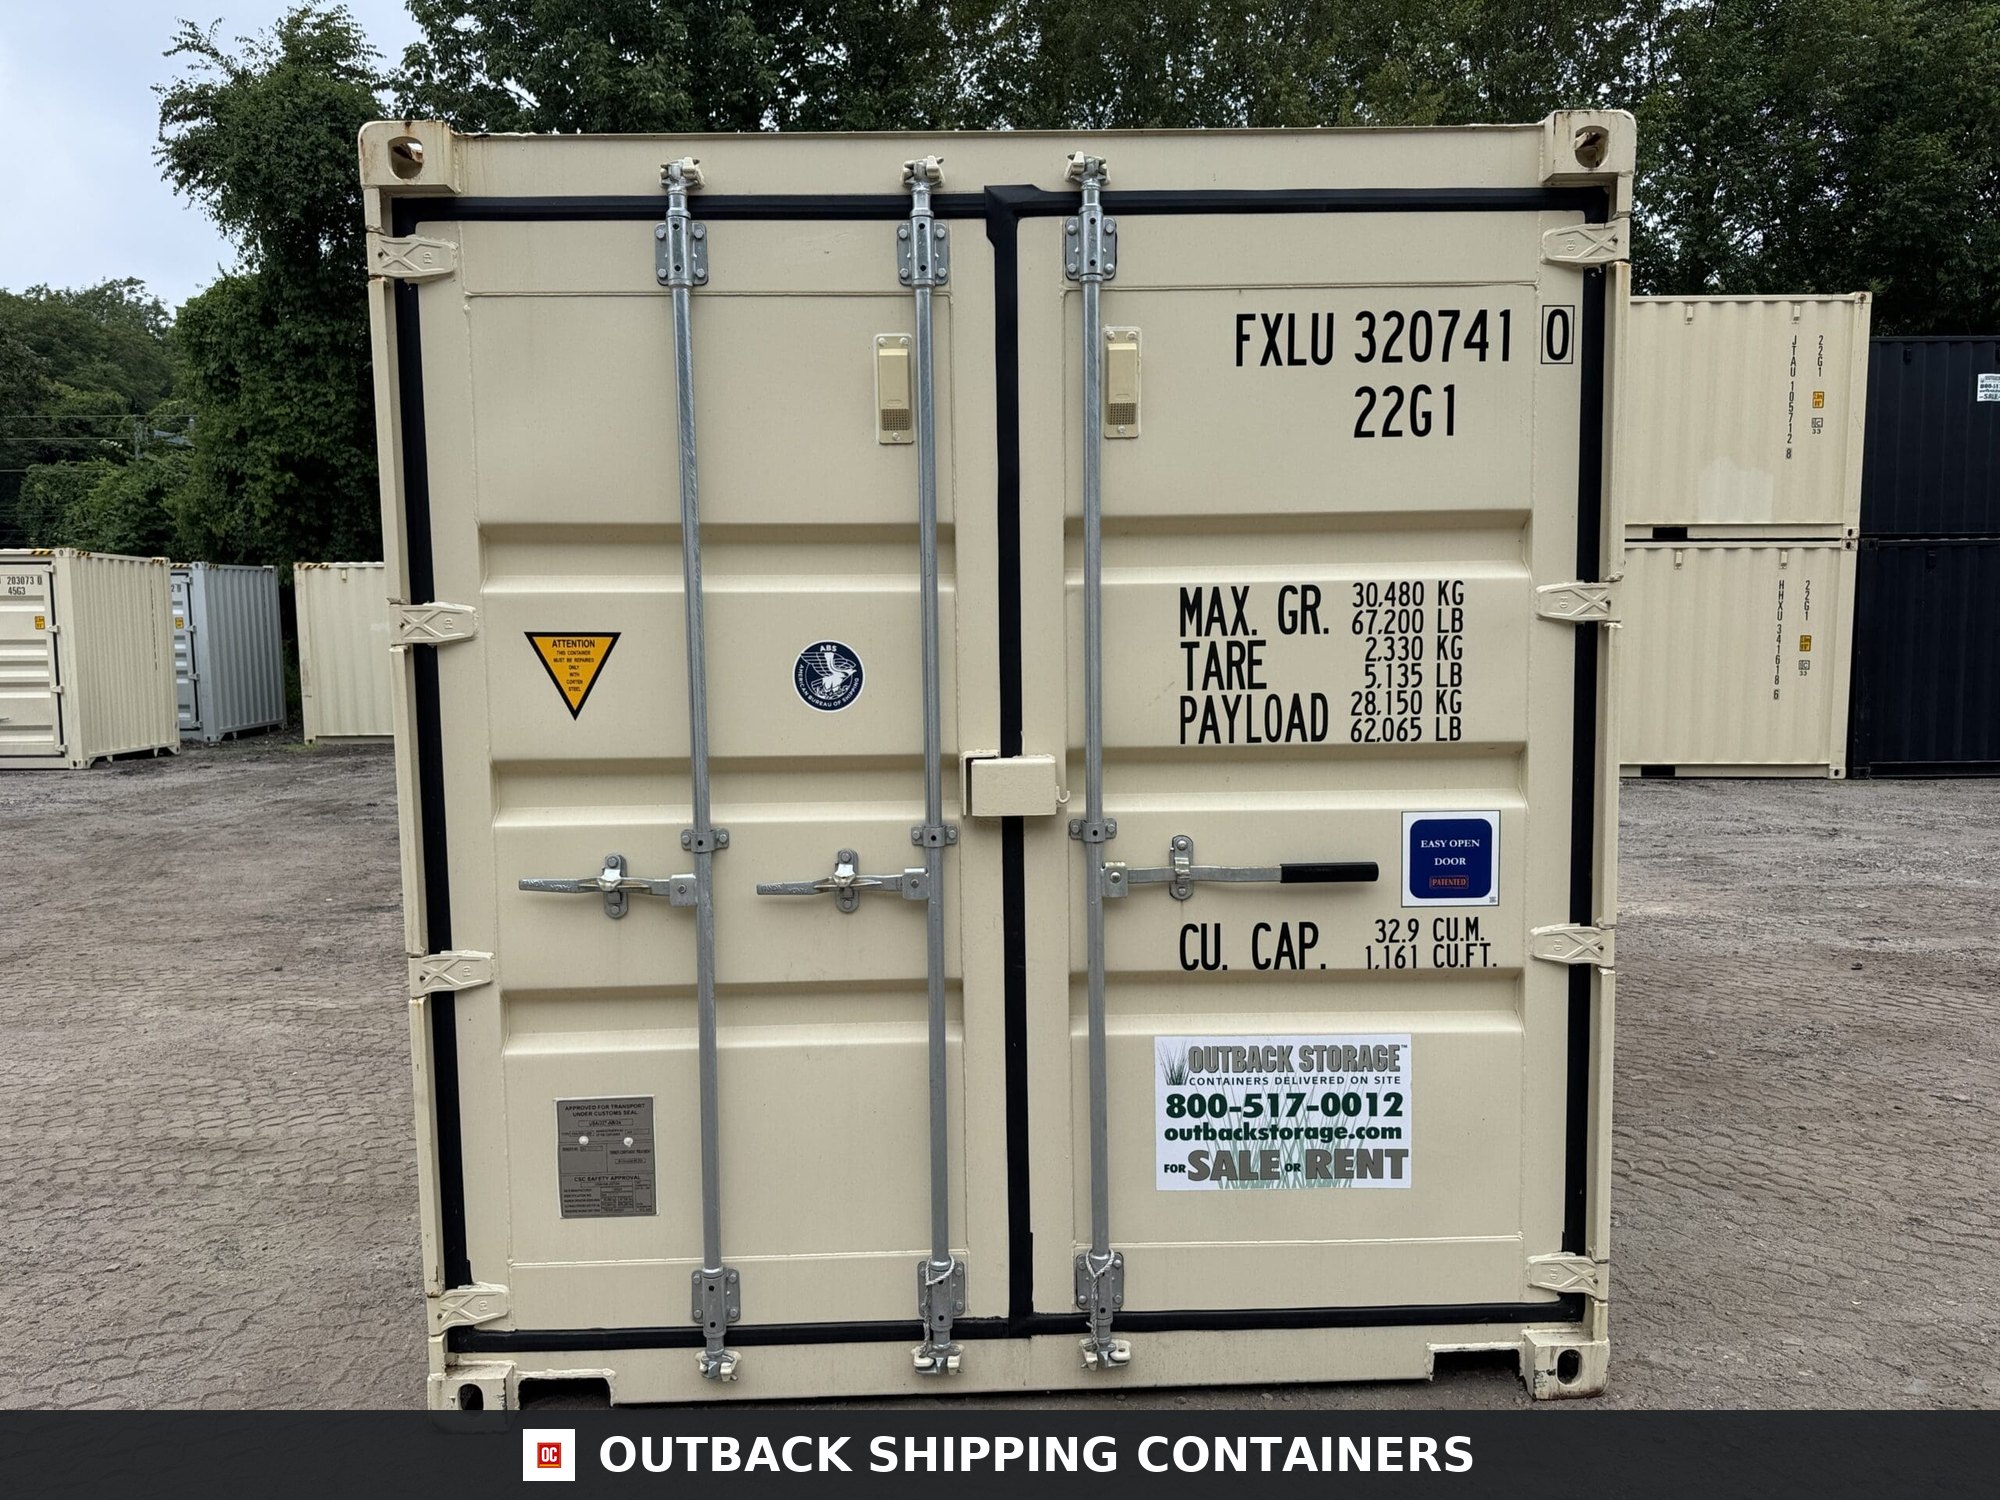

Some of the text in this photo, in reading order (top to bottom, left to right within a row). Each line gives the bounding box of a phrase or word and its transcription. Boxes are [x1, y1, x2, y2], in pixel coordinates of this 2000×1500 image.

[1236, 309, 1569, 366] FXLU 320741 0
[1354, 384, 1454, 438] 22G1
[1786, 448, 1792, 459] 8
[6, 575, 35, 586] 203073
[8, 586, 26, 596] 45G3
[1180, 580, 1463, 637] MAX. GR. 30,480 KG
[1352, 608, 1463, 635] 67,200 LB
[552, 639, 595, 648] ATTENTION
[1773, 580, 1785, 700] HHXU 341618 6
[1181, 635, 1462, 691] TARE 2,330 KG
[1365, 662, 1462, 691] 5,135 LB
[798, 664, 808, 695] AMERICAN
[808, 696, 832, 707] BUREAU
[842, 678, 860, 703] SHIPPING
[1180, 689, 1461, 744] PAYLOAD 28,150 KG
[1351, 716, 1461, 742] 62,065 LB
[1420, 839, 1480, 848] EASY OPEN
[1434, 857, 1467, 866] DOOR
[1432, 878, 1466, 886] PATENTED
[1180, 917, 1484, 971] CU. CAP. 32.9 CU.M.
[1365, 941, 1498, 970] 1,161 CU.FT.
[1187, 1044, 1295, 1074] OUTBACK
[1189, 1075, 1401, 1085] CONTAINERS DELIVERED ON SITE
[1165, 1092, 1404, 1119] 800-517-0012
[1164, 1122, 1402, 1143] outbackstorage.com
[1164, 1148, 1409, 1181] FOR SALE OR RENT
